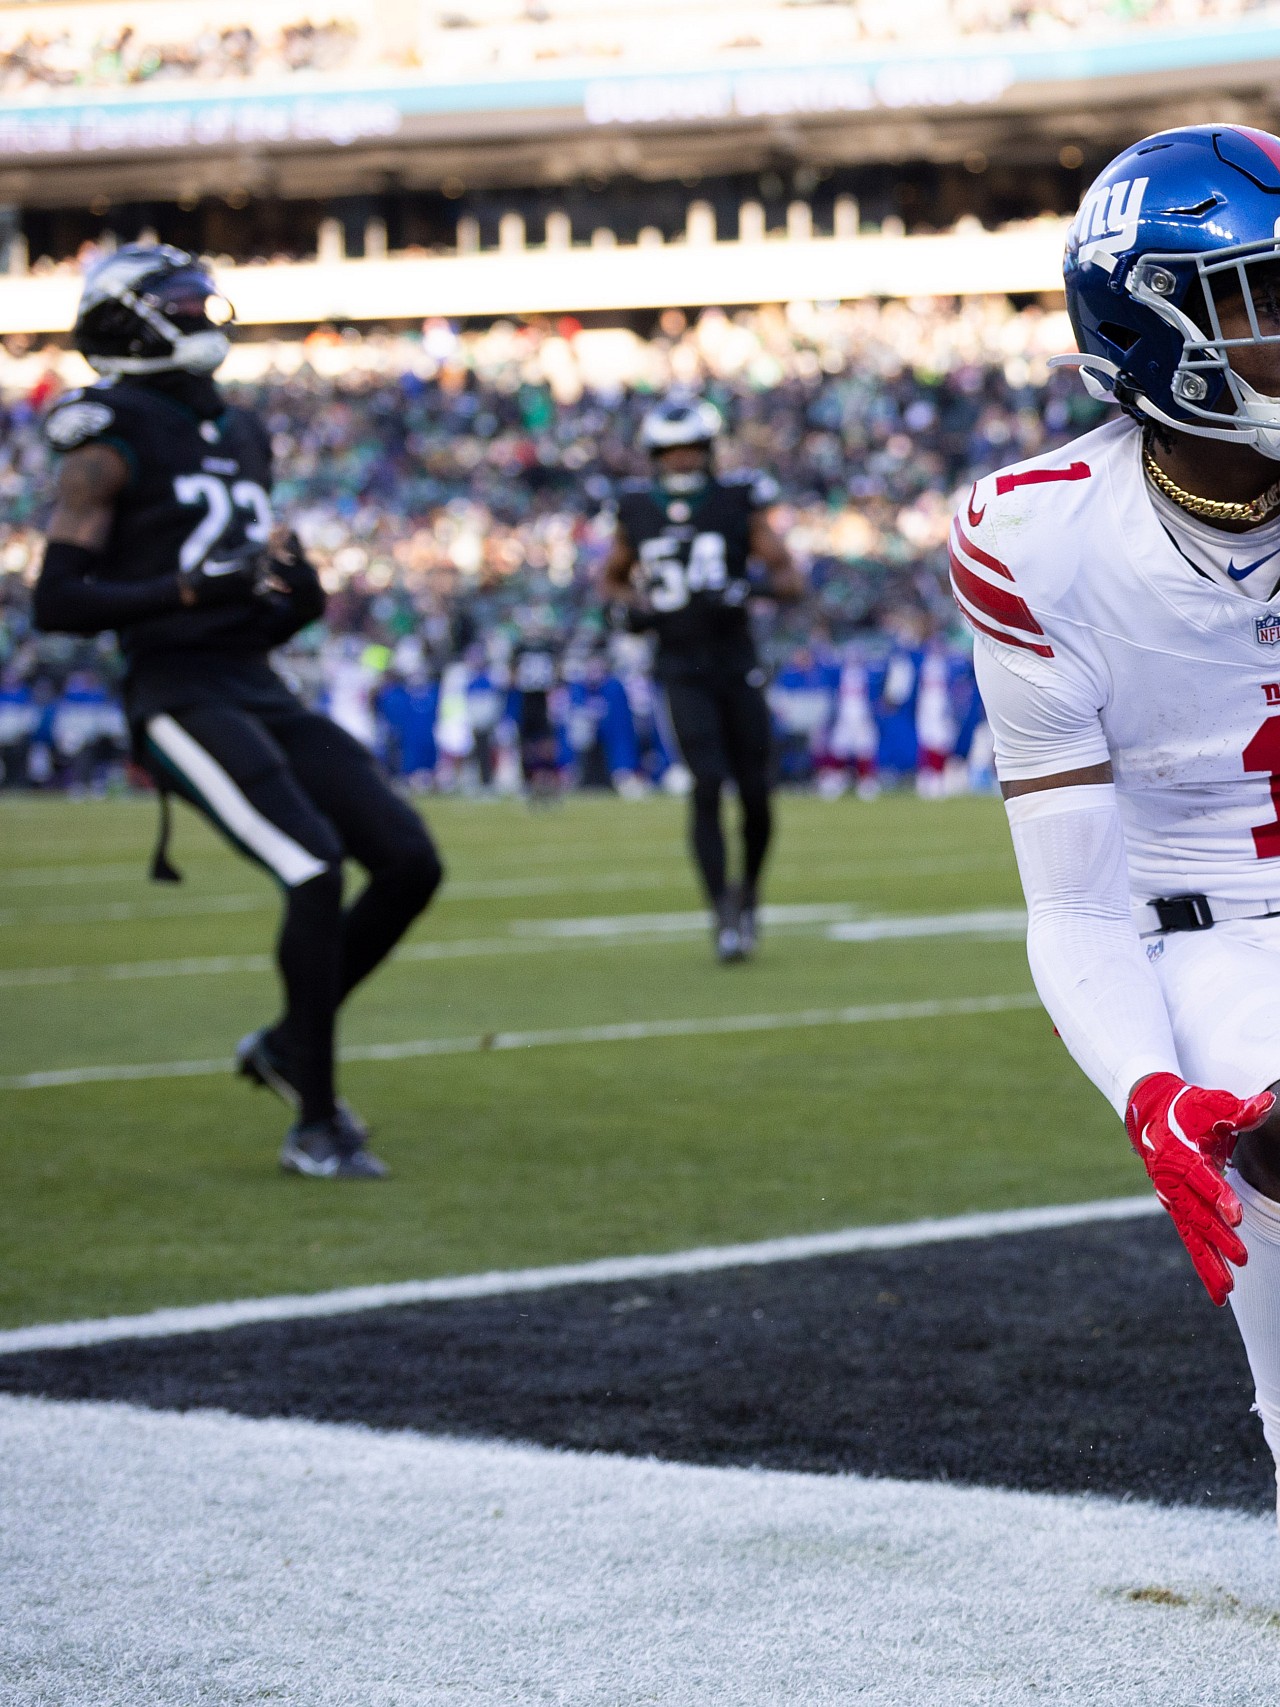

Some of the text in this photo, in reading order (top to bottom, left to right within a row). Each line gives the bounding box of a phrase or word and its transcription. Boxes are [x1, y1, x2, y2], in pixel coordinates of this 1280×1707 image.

[1074, 177, 1150, 264] ny
[995, 461, 1092, 496] 1
[636, 531, 728, 612] 54
